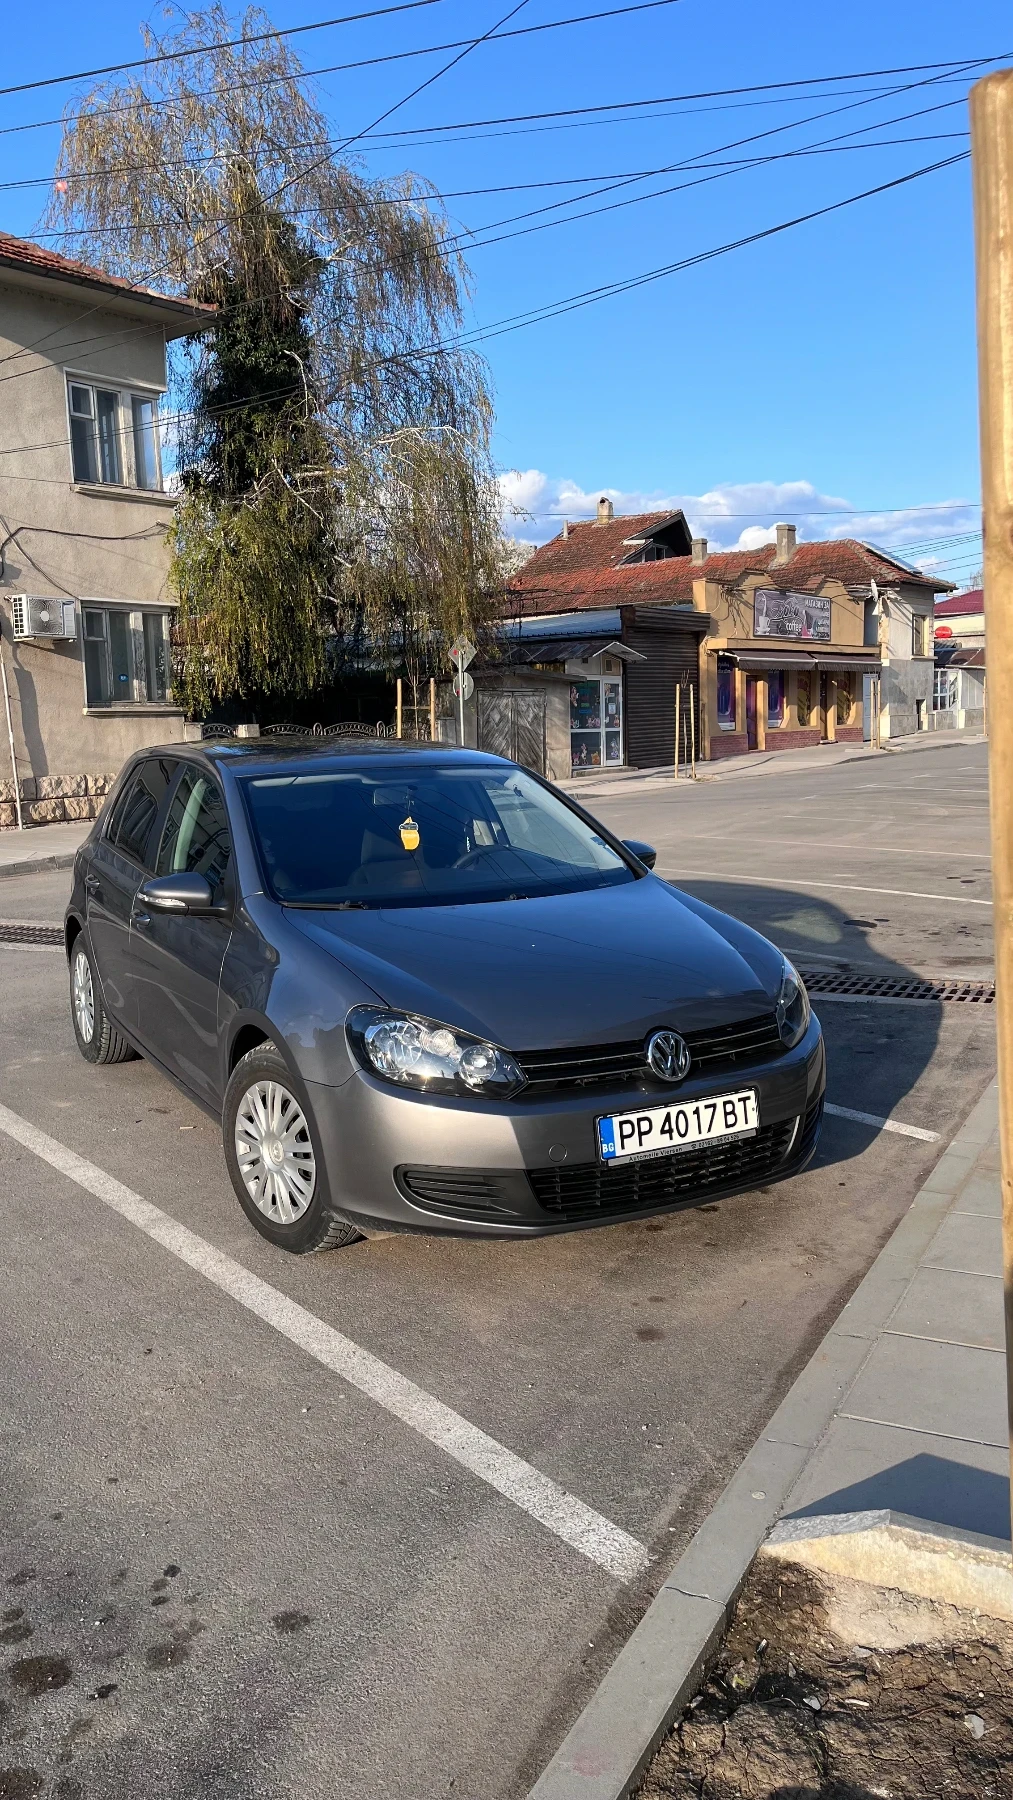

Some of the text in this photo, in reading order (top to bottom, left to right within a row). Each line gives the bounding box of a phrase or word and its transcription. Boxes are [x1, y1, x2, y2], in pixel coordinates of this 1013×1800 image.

[785, 619, 802, 632] coffee
[619, 1096, 752, 1150] PP 4017 BT
[602, 1142, 615, 1153] BG
[659, 1147, 683, 1156] Viersen
